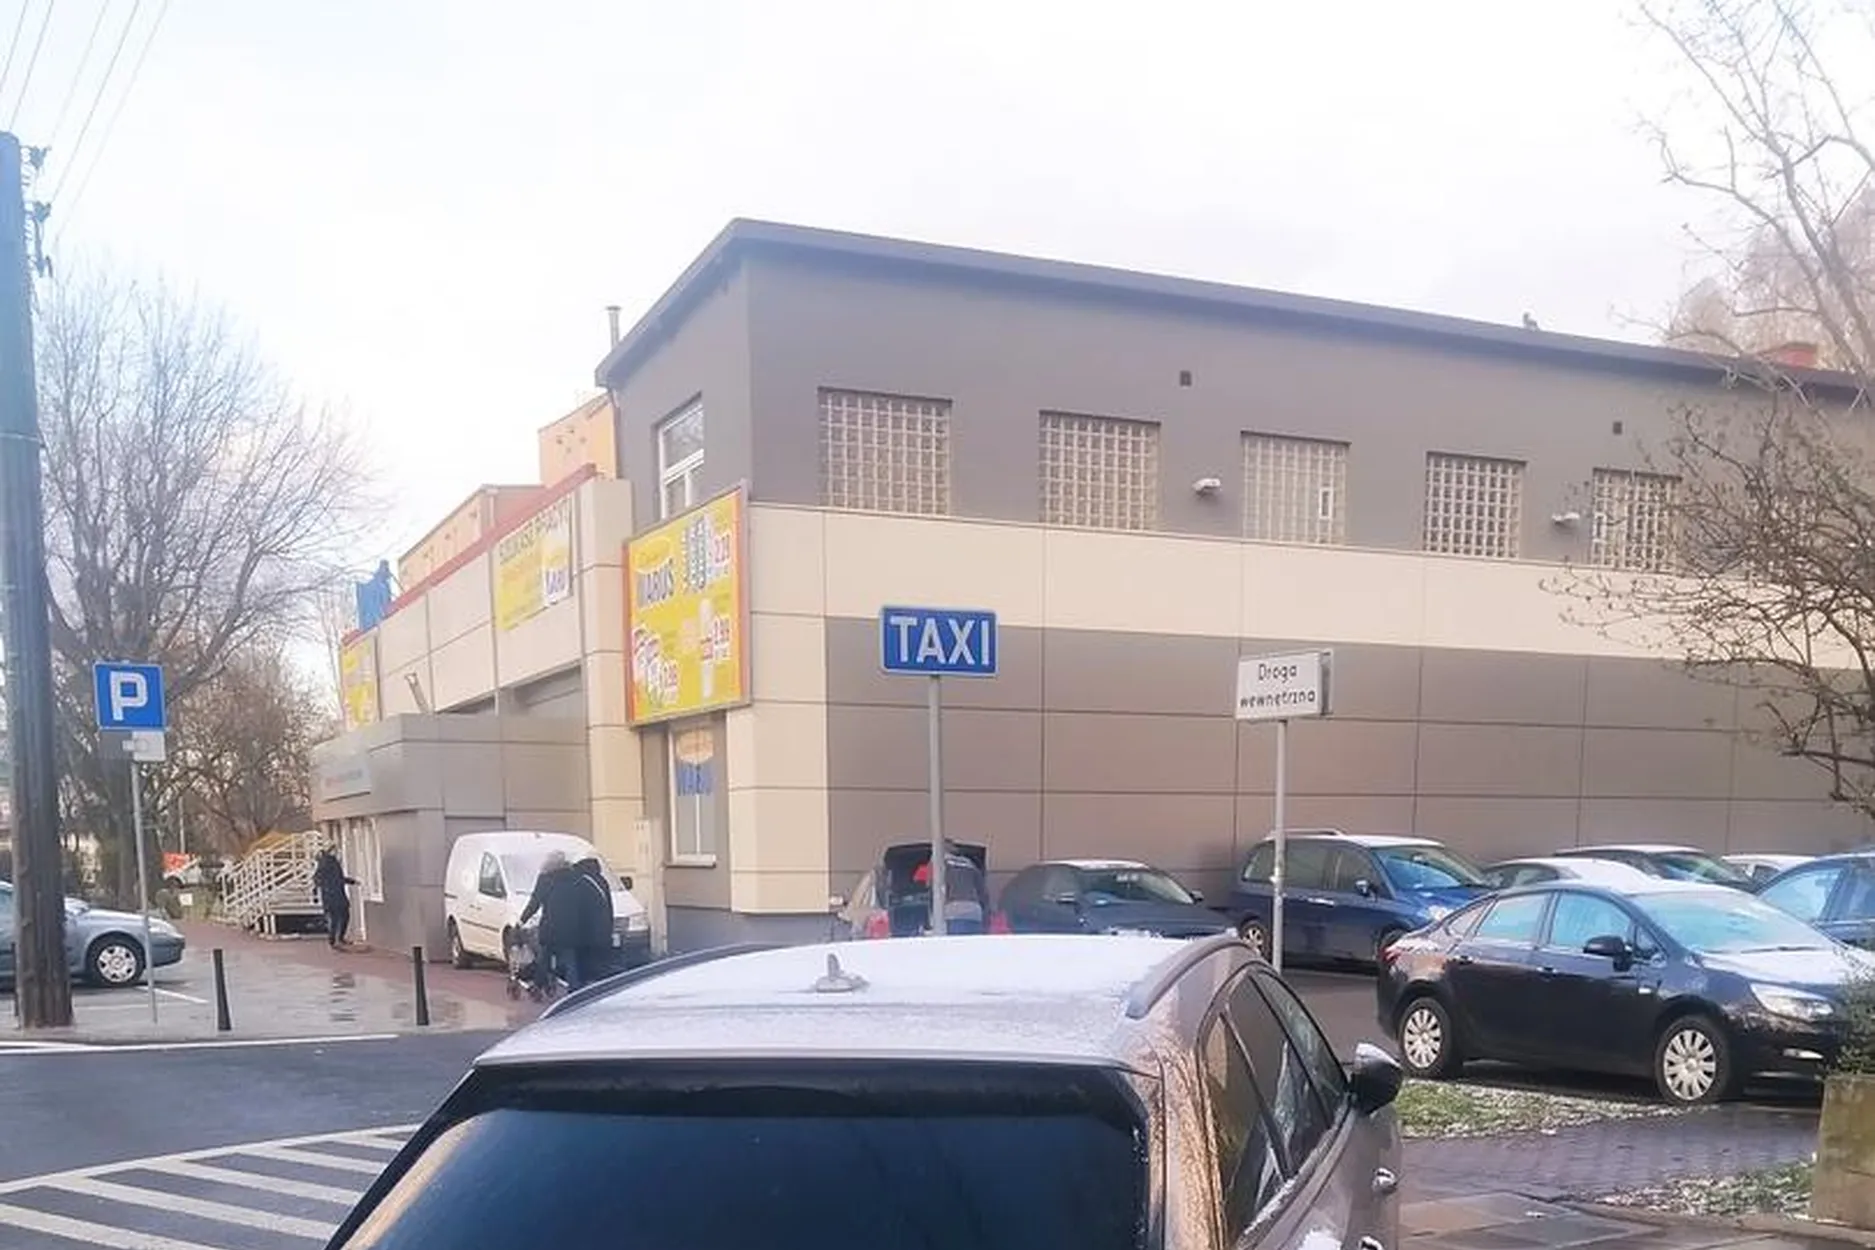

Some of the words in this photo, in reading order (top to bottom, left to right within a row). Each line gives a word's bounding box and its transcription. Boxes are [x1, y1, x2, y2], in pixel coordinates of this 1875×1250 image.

[890, 615, 989, 665] TAXI
[109, 670, 148, 721] P
[1258, 663, 1297, 684] Droga
